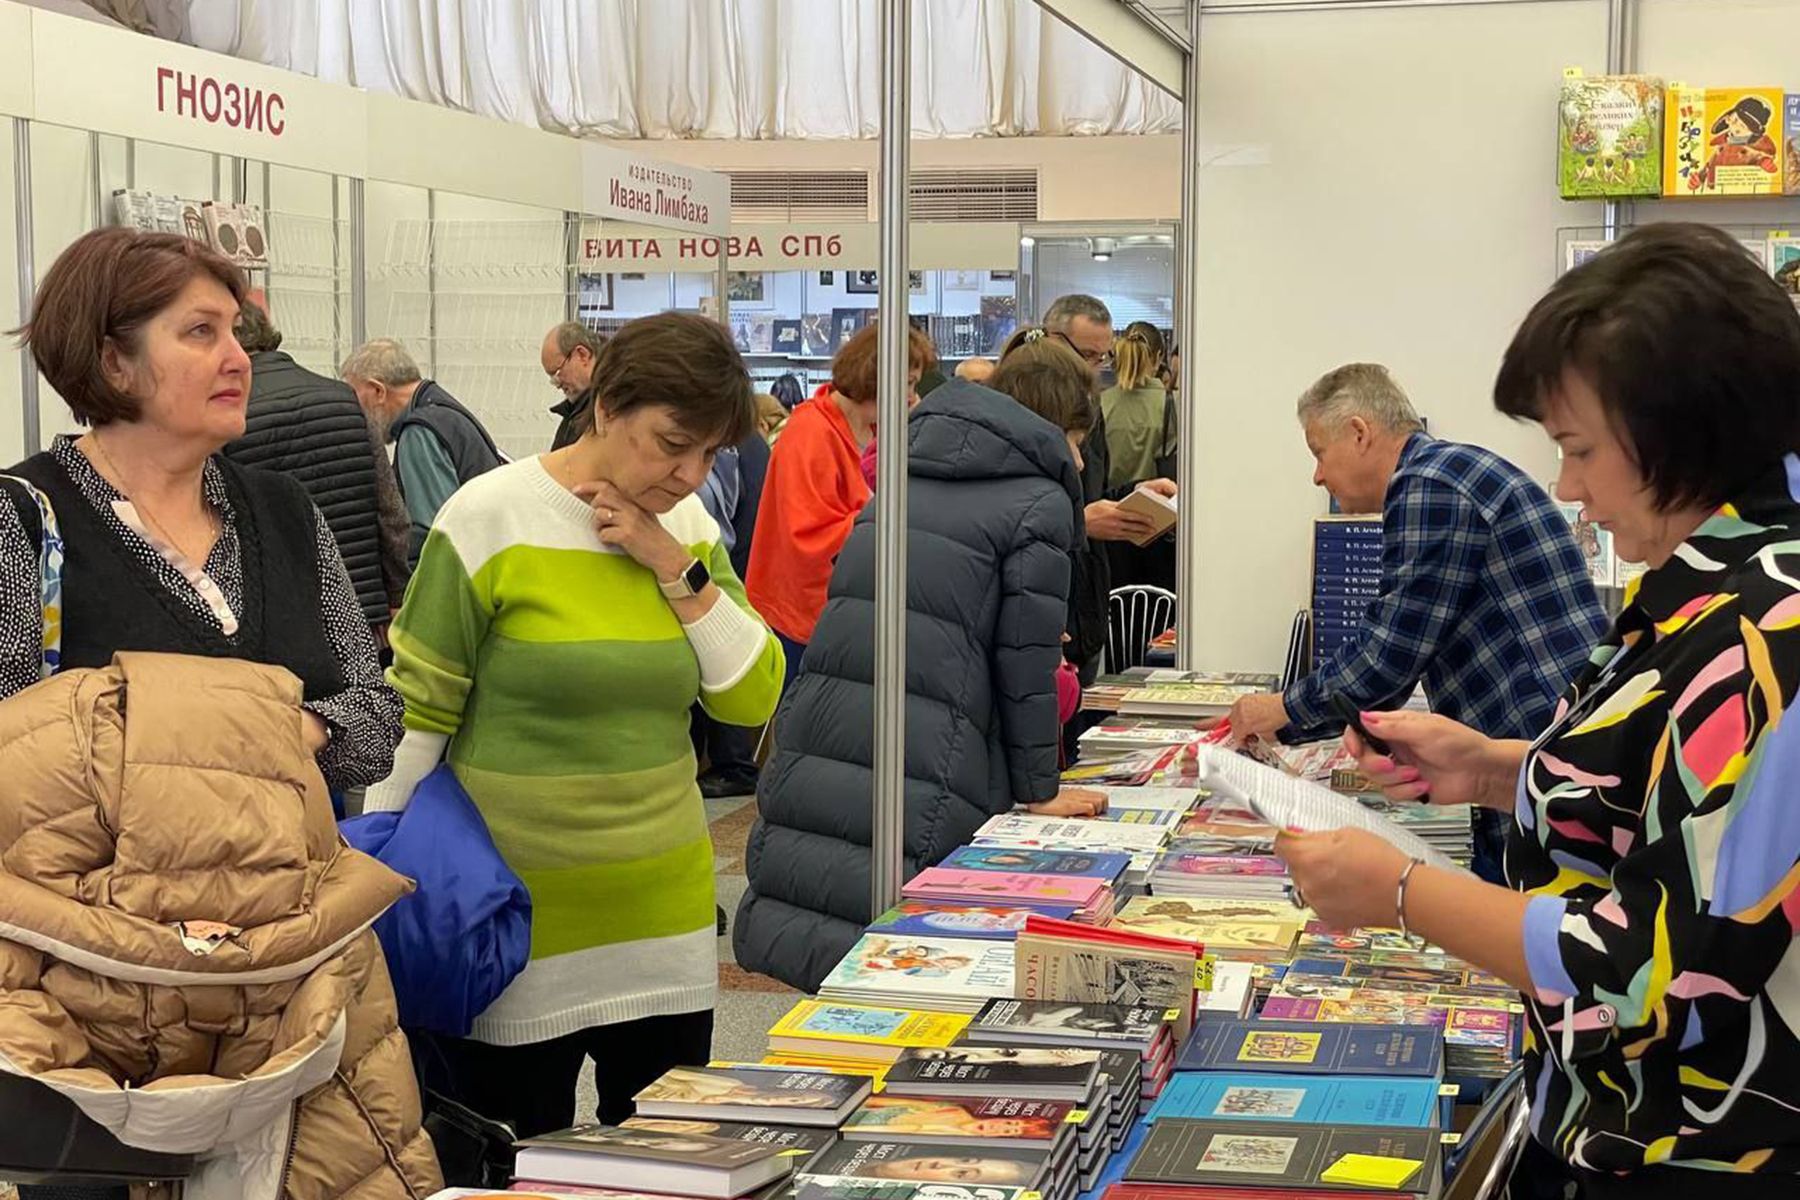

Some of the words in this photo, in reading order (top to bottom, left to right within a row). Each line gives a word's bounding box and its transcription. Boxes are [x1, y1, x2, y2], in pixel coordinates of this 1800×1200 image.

[157, 67, 285, 136] ГНОЗИС
[610, 177, 652, 214] Ивана
[654, 188, 709, 225] Лимбаха
[585, 238, 662, 259] ВИТА
[679, 236, 764, 259] НОВА
[781, 234, 842, 258] СПб
[1025, 955, 1038, 999] ЧАСО
